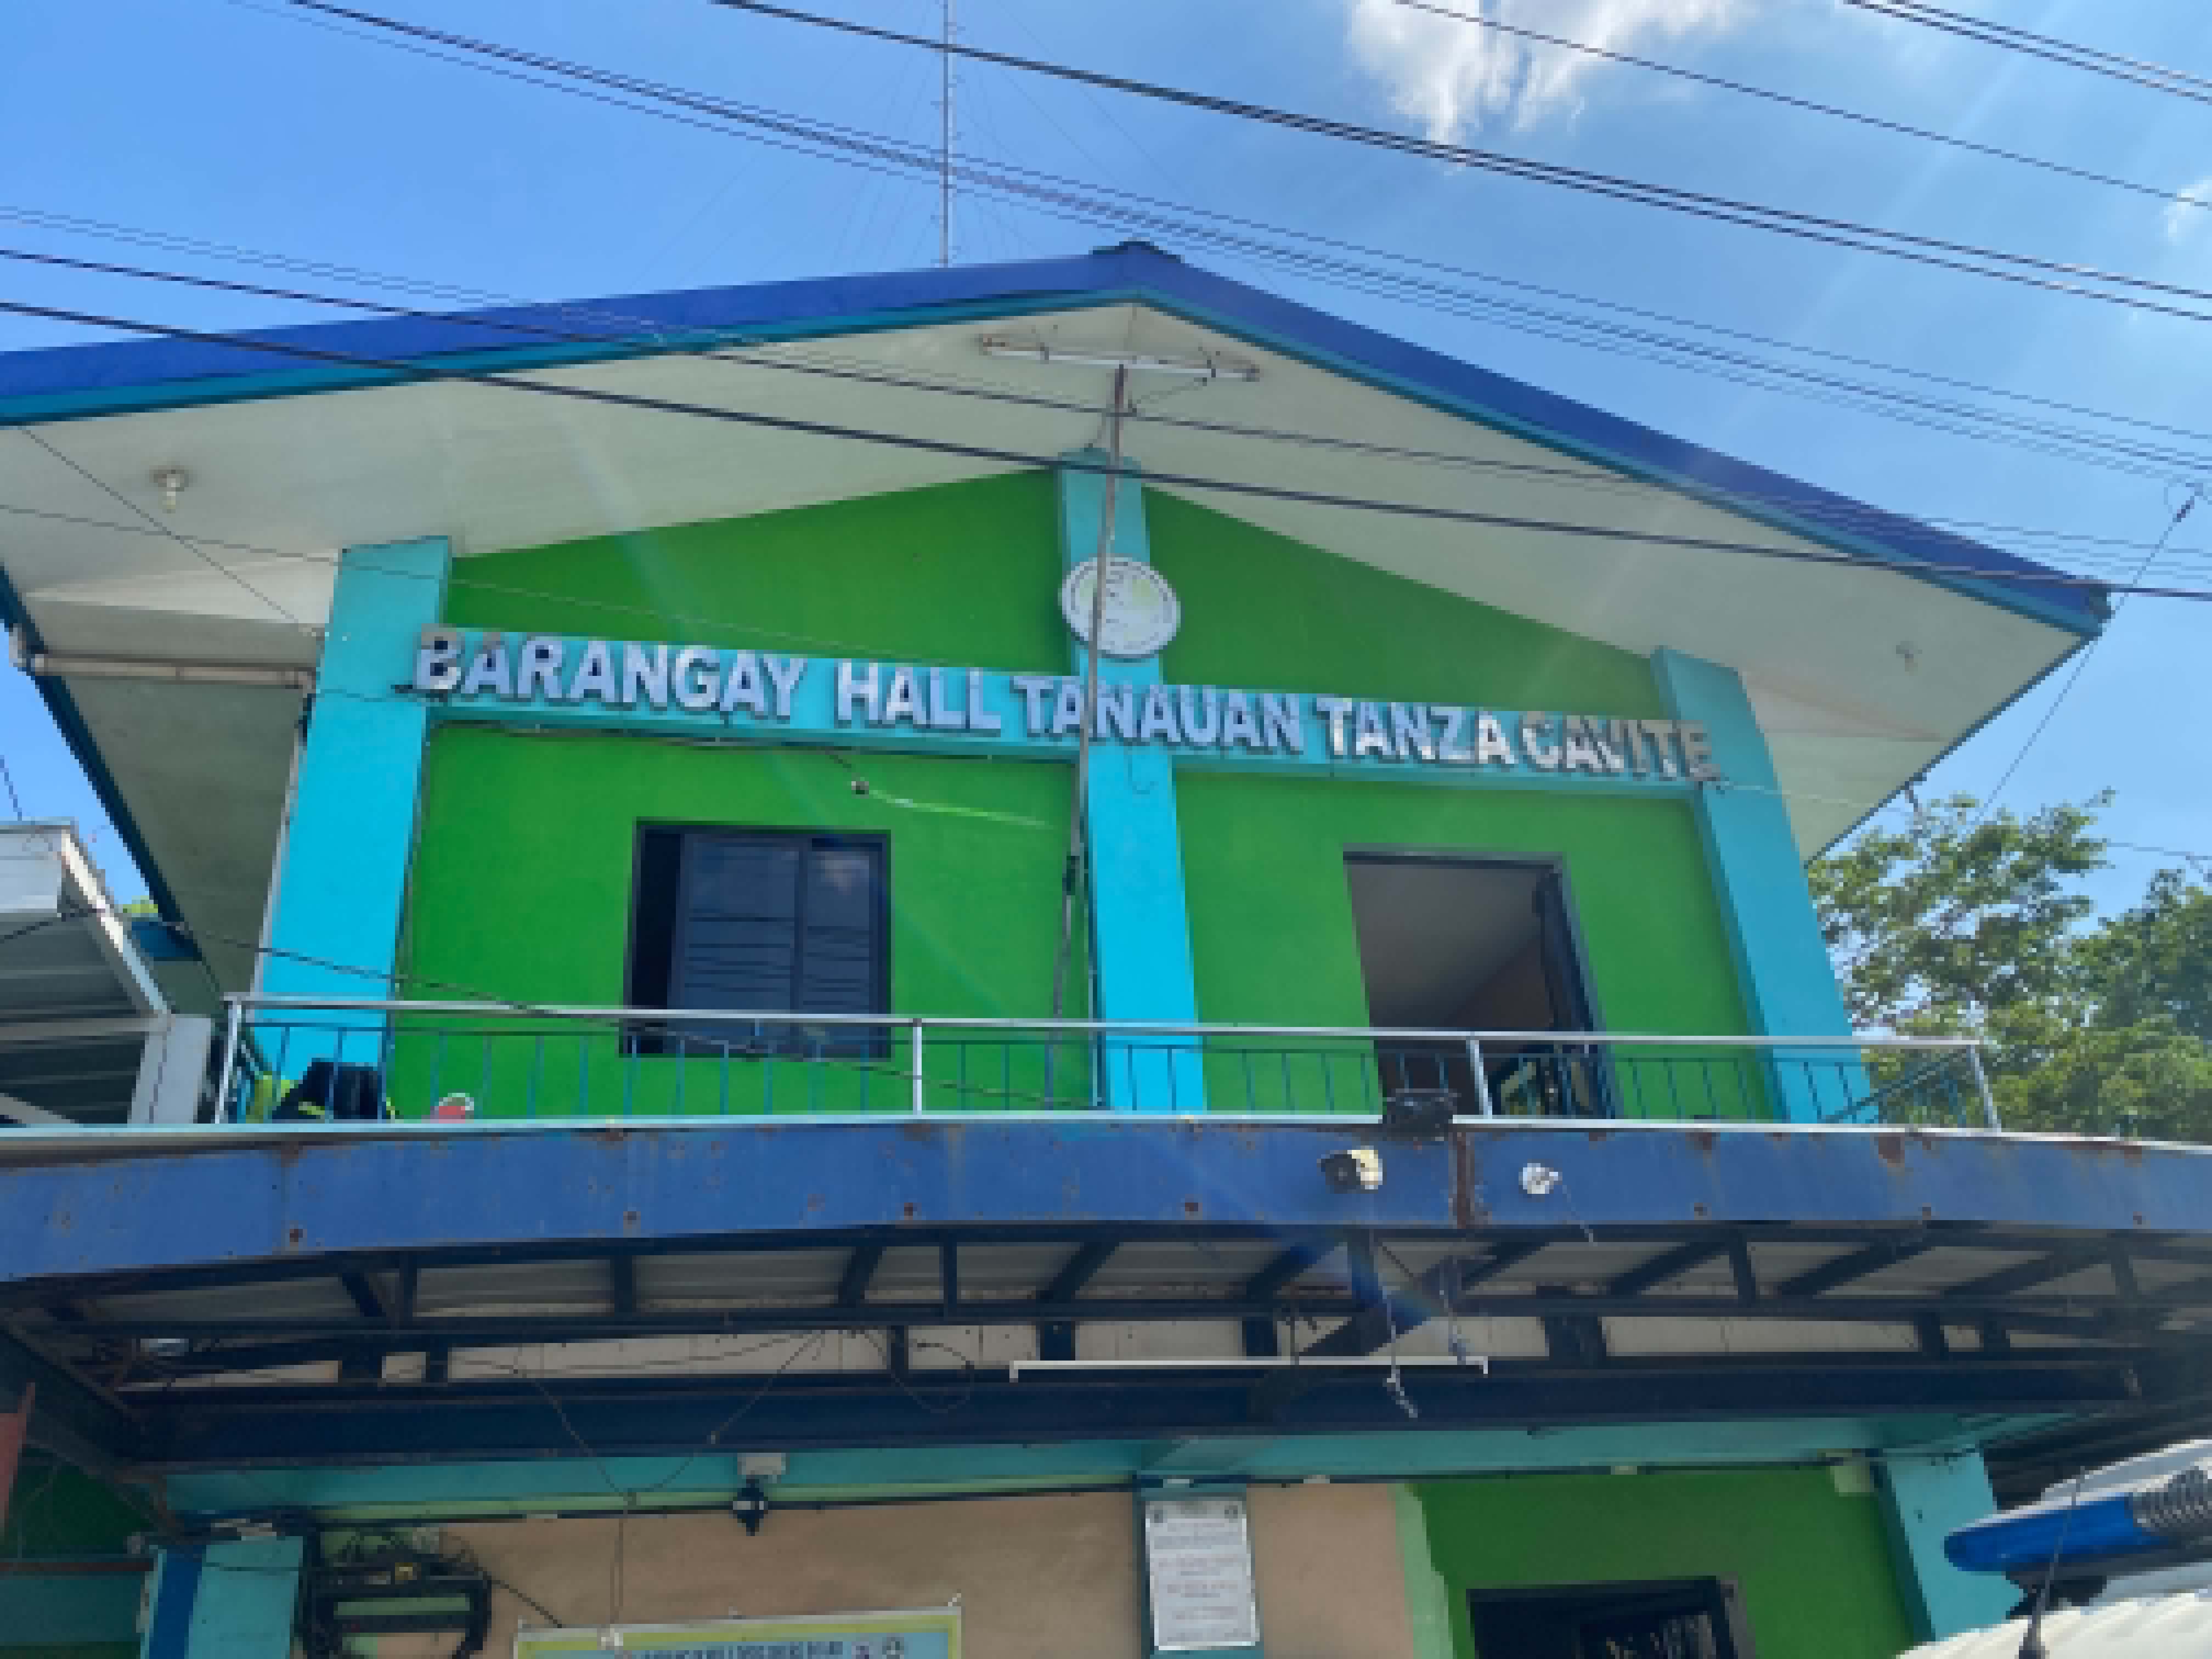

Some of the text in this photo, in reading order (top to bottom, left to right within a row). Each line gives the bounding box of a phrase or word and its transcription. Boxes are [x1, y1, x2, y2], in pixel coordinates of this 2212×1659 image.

[415, 624, 1722, 781] BARANGAY HALL TANAUAN TANZA CAVITE
